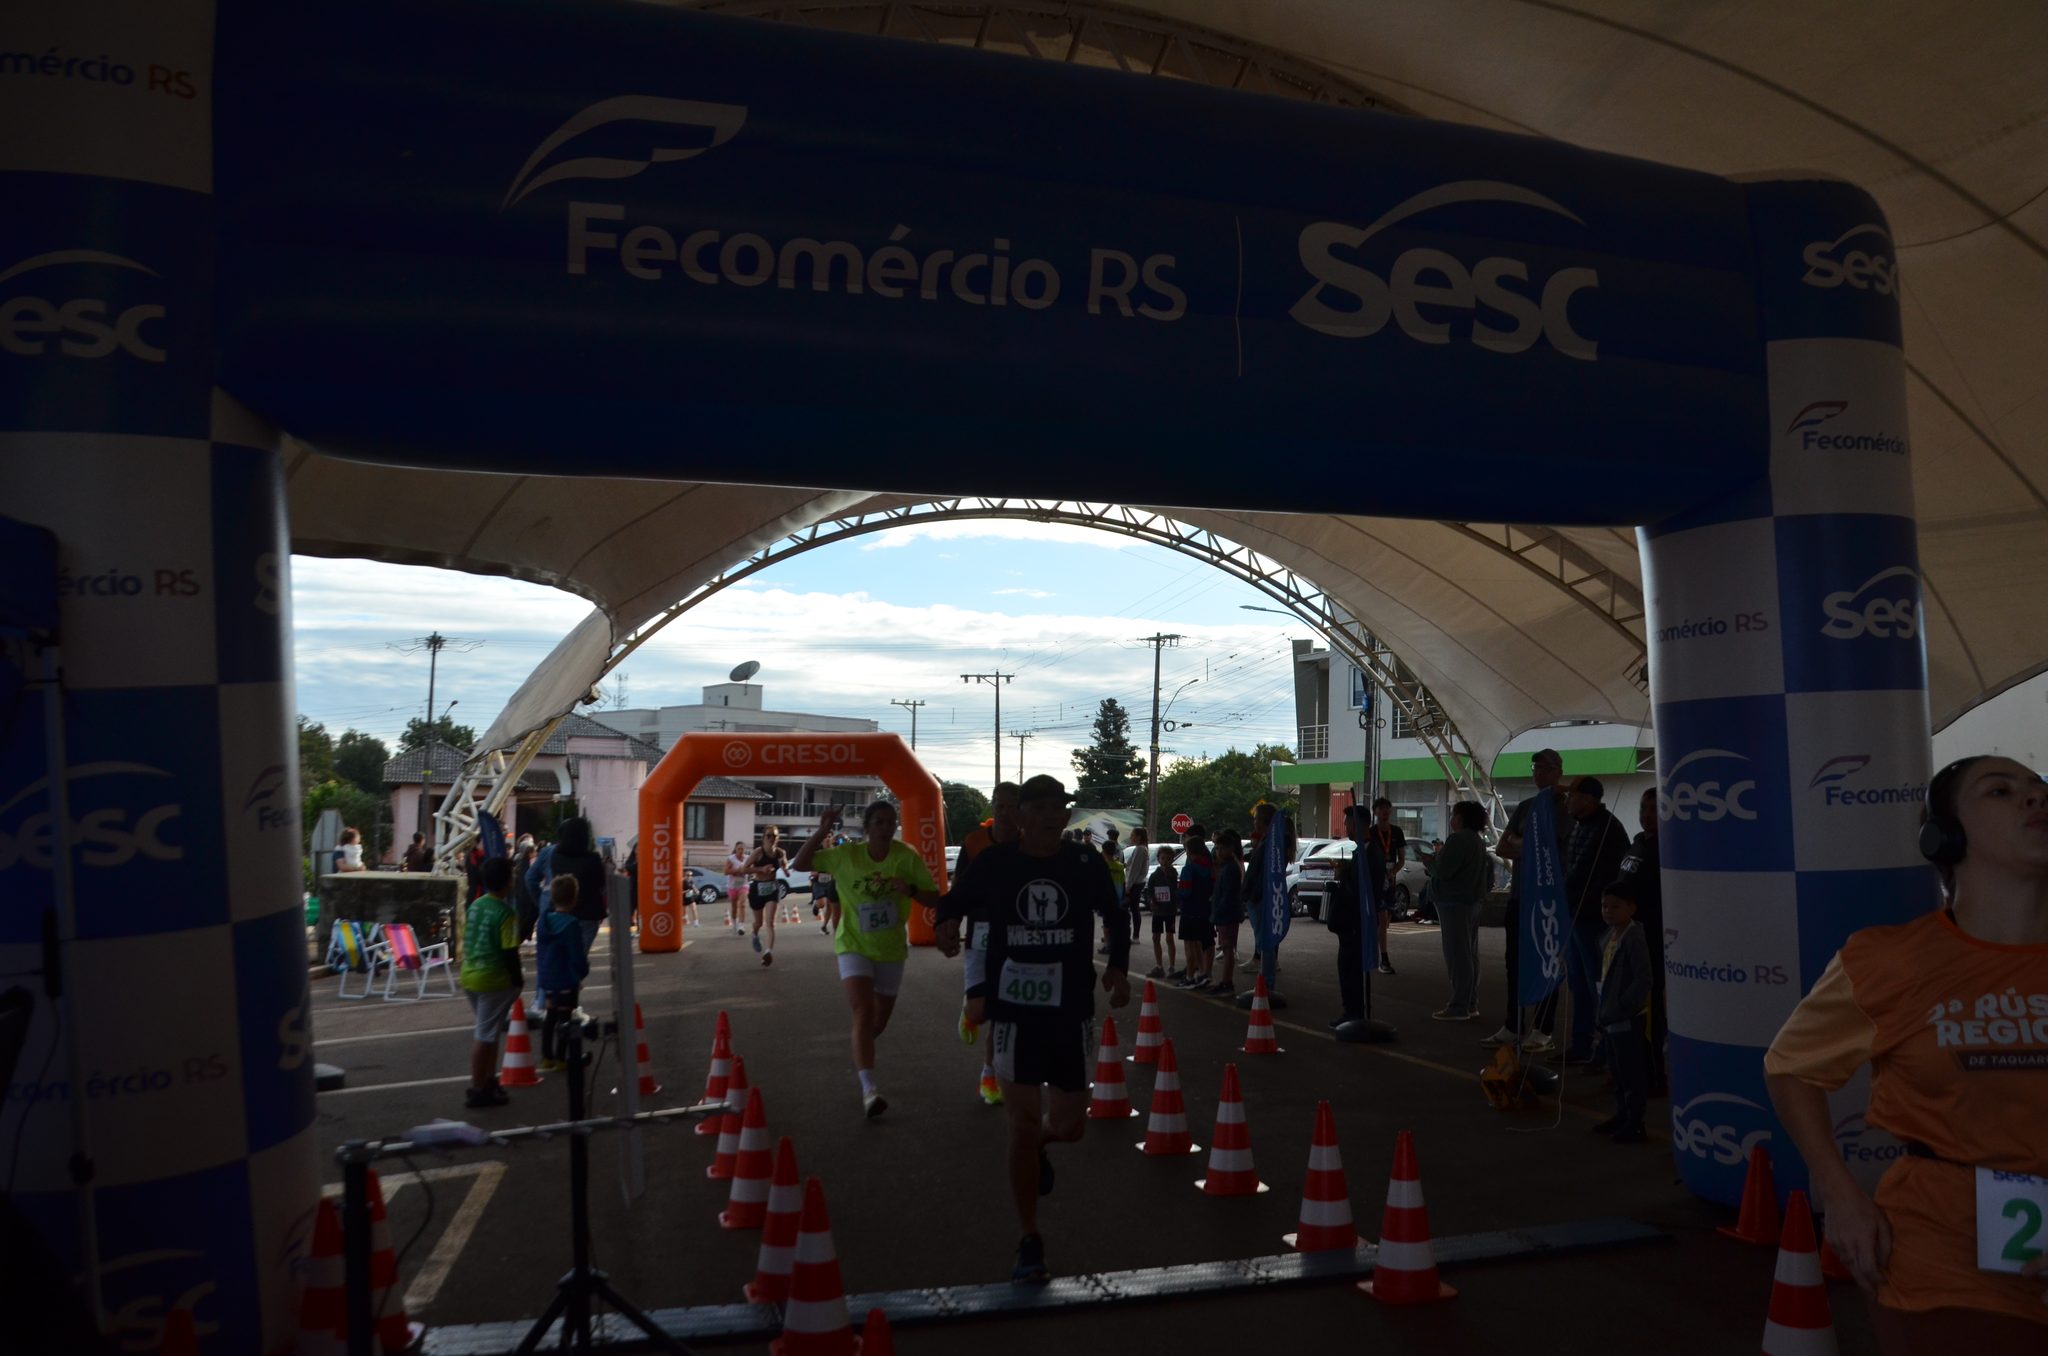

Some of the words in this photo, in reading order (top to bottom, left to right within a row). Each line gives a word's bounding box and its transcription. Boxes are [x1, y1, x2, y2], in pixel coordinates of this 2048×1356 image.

[149, 64, 197, 100] RS
[566, 202, 1061, 310] Fecomércio
[1087, 247, 1188, 322] RS
[1289, 220, 1601, 362] Sesc
[154, 569, 201, 597] RS
[1735, 612, 1769, 633] RS
[760, 743, 866, 765] CRESOL
[653, 816, 671, 905] CRESOL
[870, 911, 889, 928] 54
[1007, 925, 1075, 946] MESTRE
[1538, 899, 1561, 980] Sesc
[1754, 964, 1789, 985] RS
[1006, 979, 1053, 1002] 409
[184, 1054, 228, 1084] RS
[1969, 1055, 1986, 1065] DE
[2002, 1198, 2043, 1261] 2
